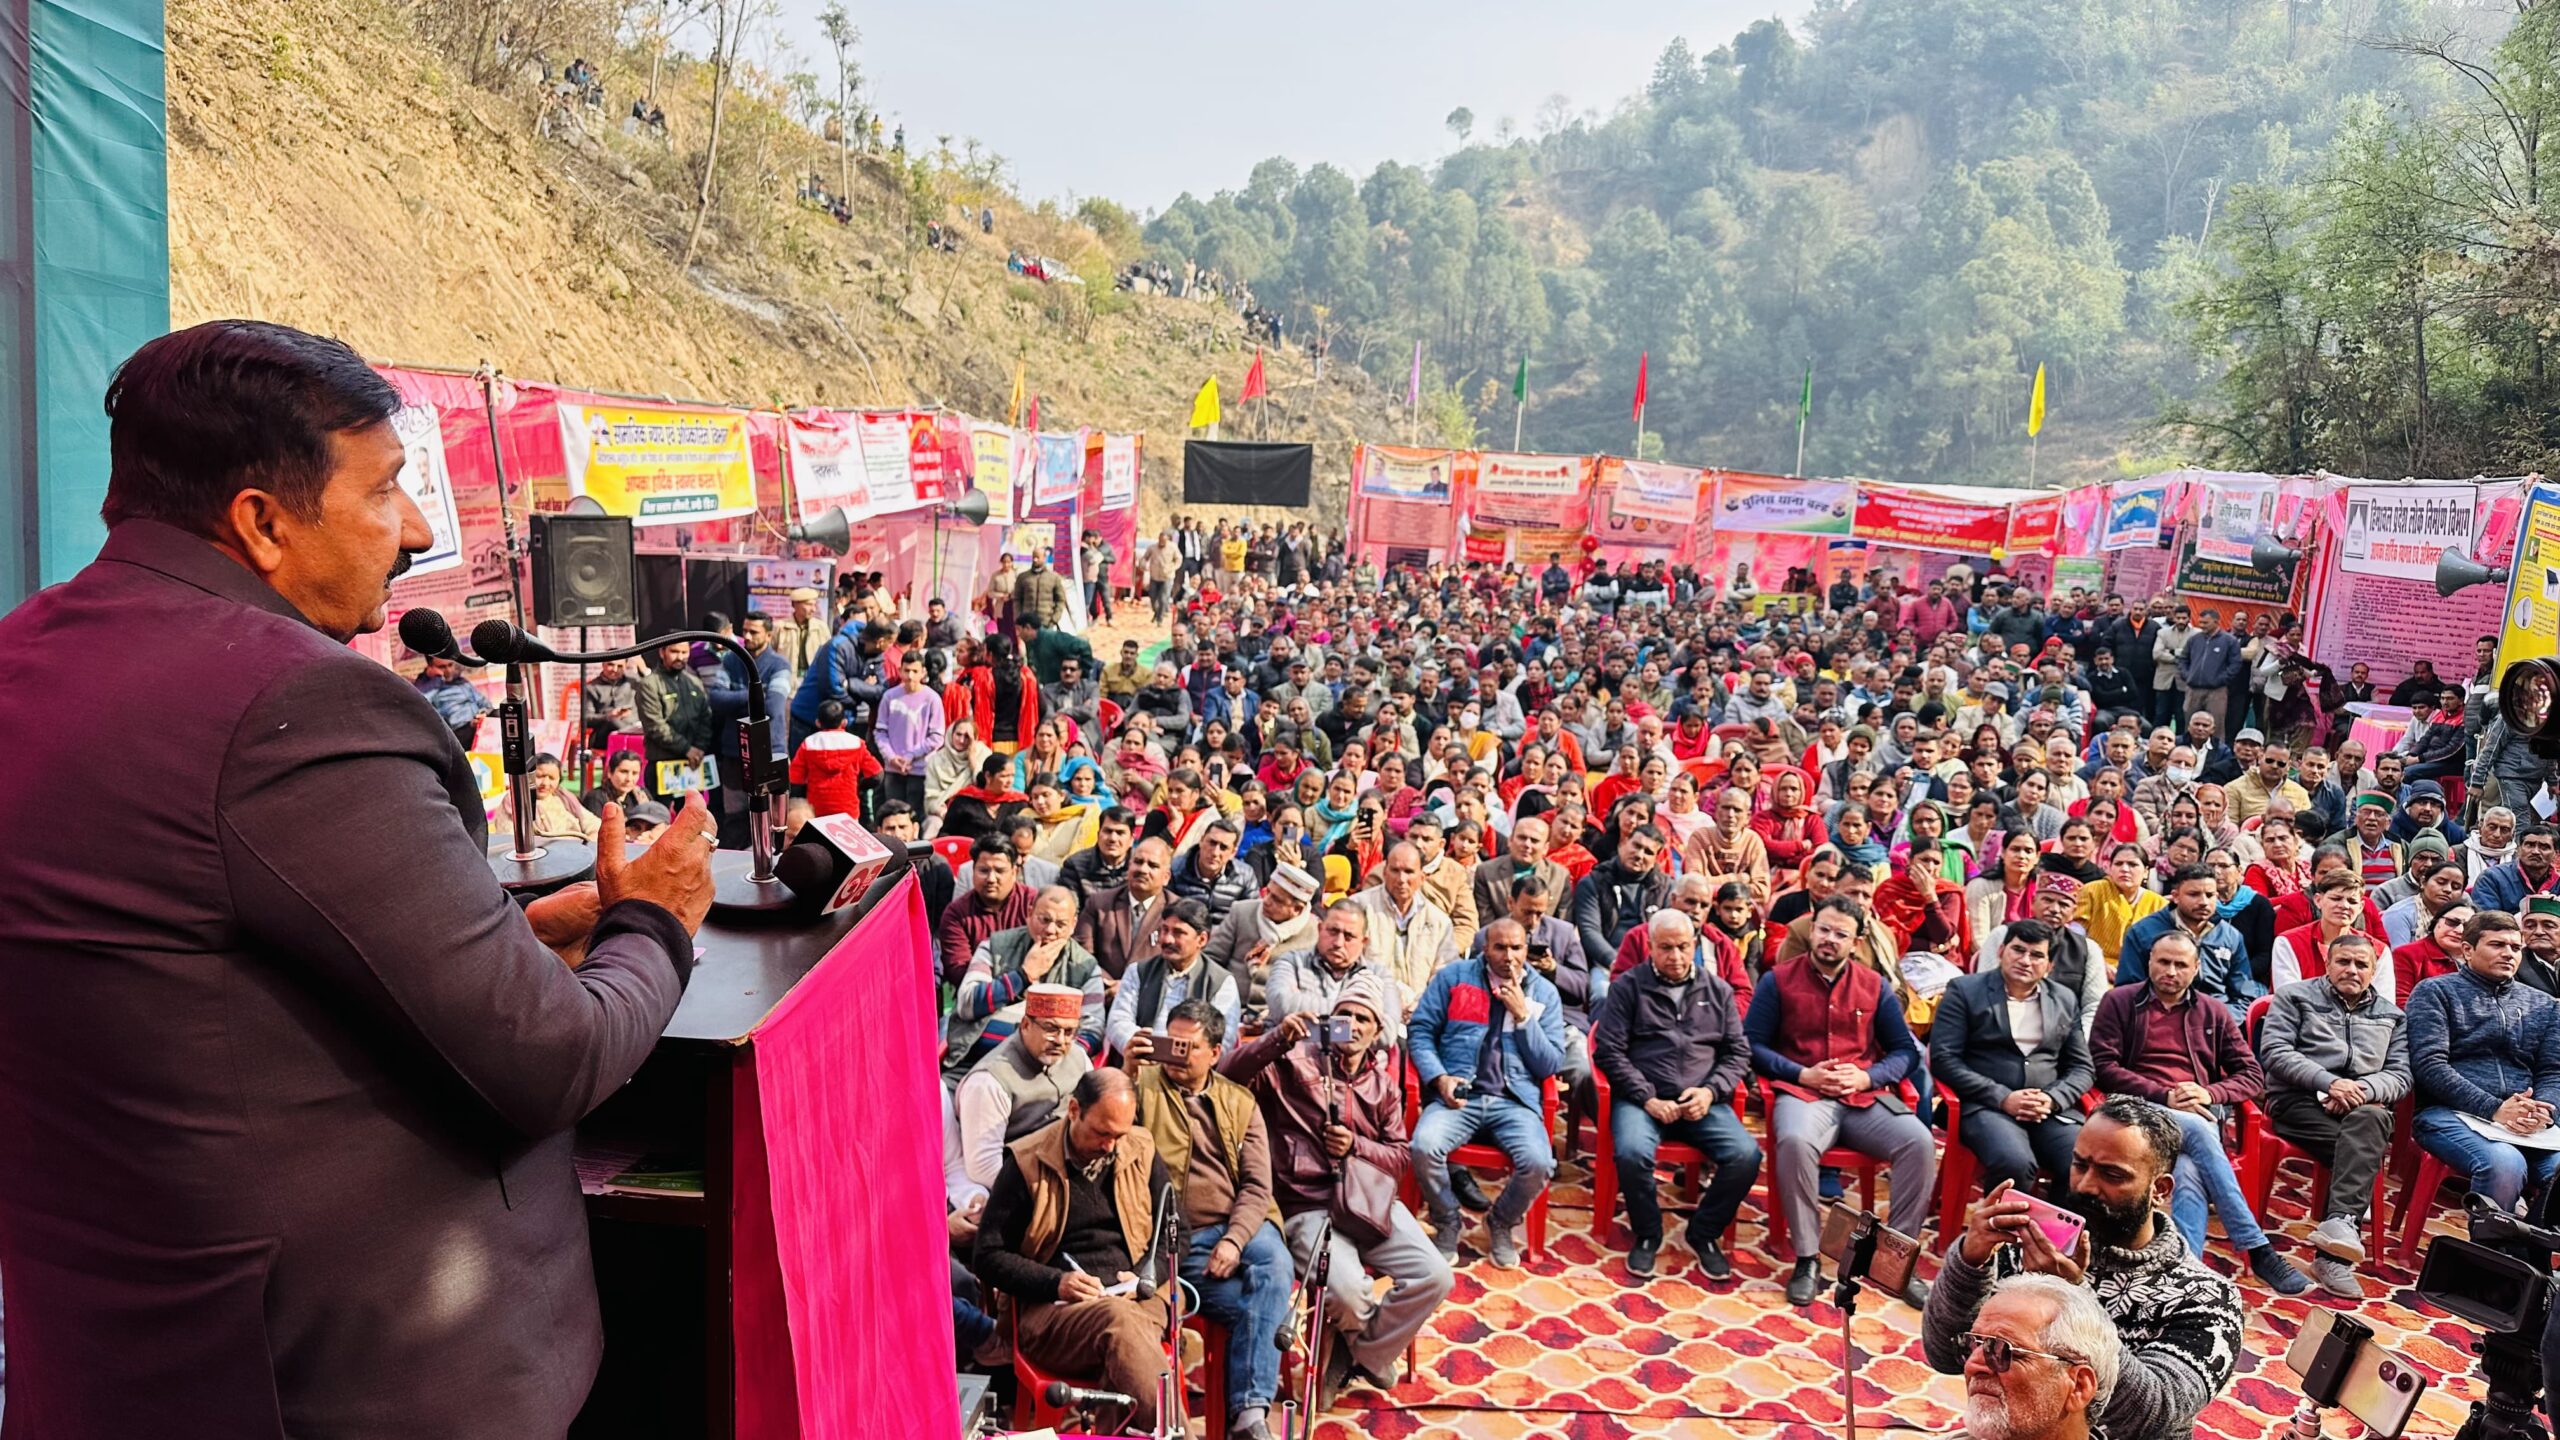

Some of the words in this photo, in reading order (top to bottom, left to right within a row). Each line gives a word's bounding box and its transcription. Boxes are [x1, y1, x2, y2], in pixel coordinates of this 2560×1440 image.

[1742, 494, 1775, 510] पुलिस
[1778, 495, 1804, 507] थाना
[2232, 503, 2252, 521] विभाग
[2370, 498, 2393, 532] हिमाचल
[2393, 499, 2408, 533] प्रदेश
[2408, 499, 2424, 534] लोक
[2424, 499, 2447, 535] निर्माण
[2447, 499, 2470, 537] विभाग
